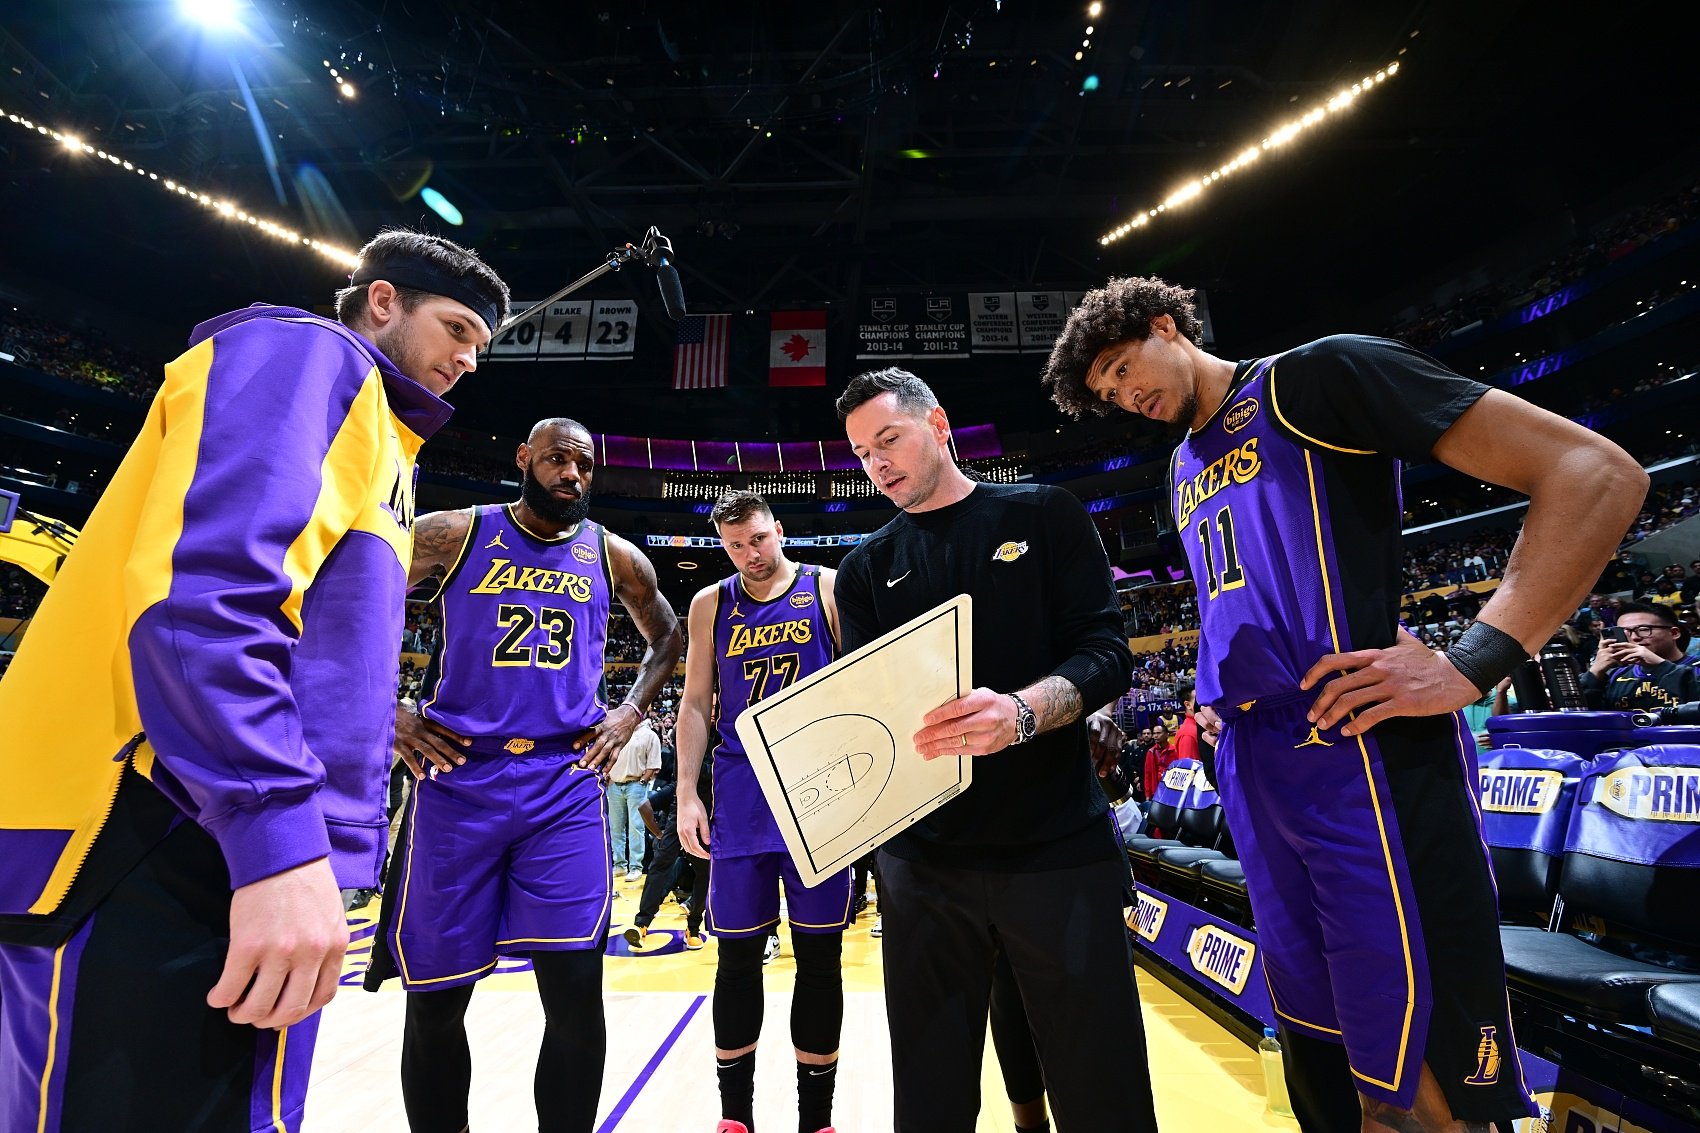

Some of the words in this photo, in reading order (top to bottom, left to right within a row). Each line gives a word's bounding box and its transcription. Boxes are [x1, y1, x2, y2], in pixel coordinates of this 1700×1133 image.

[600, 307, 631, 315] BROWN
[498, 321, 535, 346] 20
[555, 321, 573, 345] 4
[595, 320, 630, 345] 23
[860, 324, 891, 332] STANLEY
[893, 324, 909, 332] CUP
[860, 332, 909, 340] CHAMPIONS
[915, 324, 947, 332] STANLEY
[949, 323, 965, 331] CUP
[915, 331, 965, 339] CHAMPIONS
[867, 342, 902, 351] 2013-14
[924, 341, 958, 351] 2011-12
[1226, 404, 1256, 426] bibigo
[1176, 437, 1262, 534] LAKERS
[574, 546, 597, 560] bibigo
[826, 537, 832, 546] 0
[1198, 504, 1246, 601] 11
[469, 558, 592, 603] LAKERS
[492, 604, 574, 670] 23
[726, 618, 812, 658] LAKERS
[743, 652, 800, 709] 77
[1635, 681, 1679, 708] ANGELE
[1147, 702, 1162, 712] 17x
[1170, 771, 1189, 788] PRIME
[1481, 775, 1546, 807] PRIME
[1199, 932, 1246, 985] PRIME
